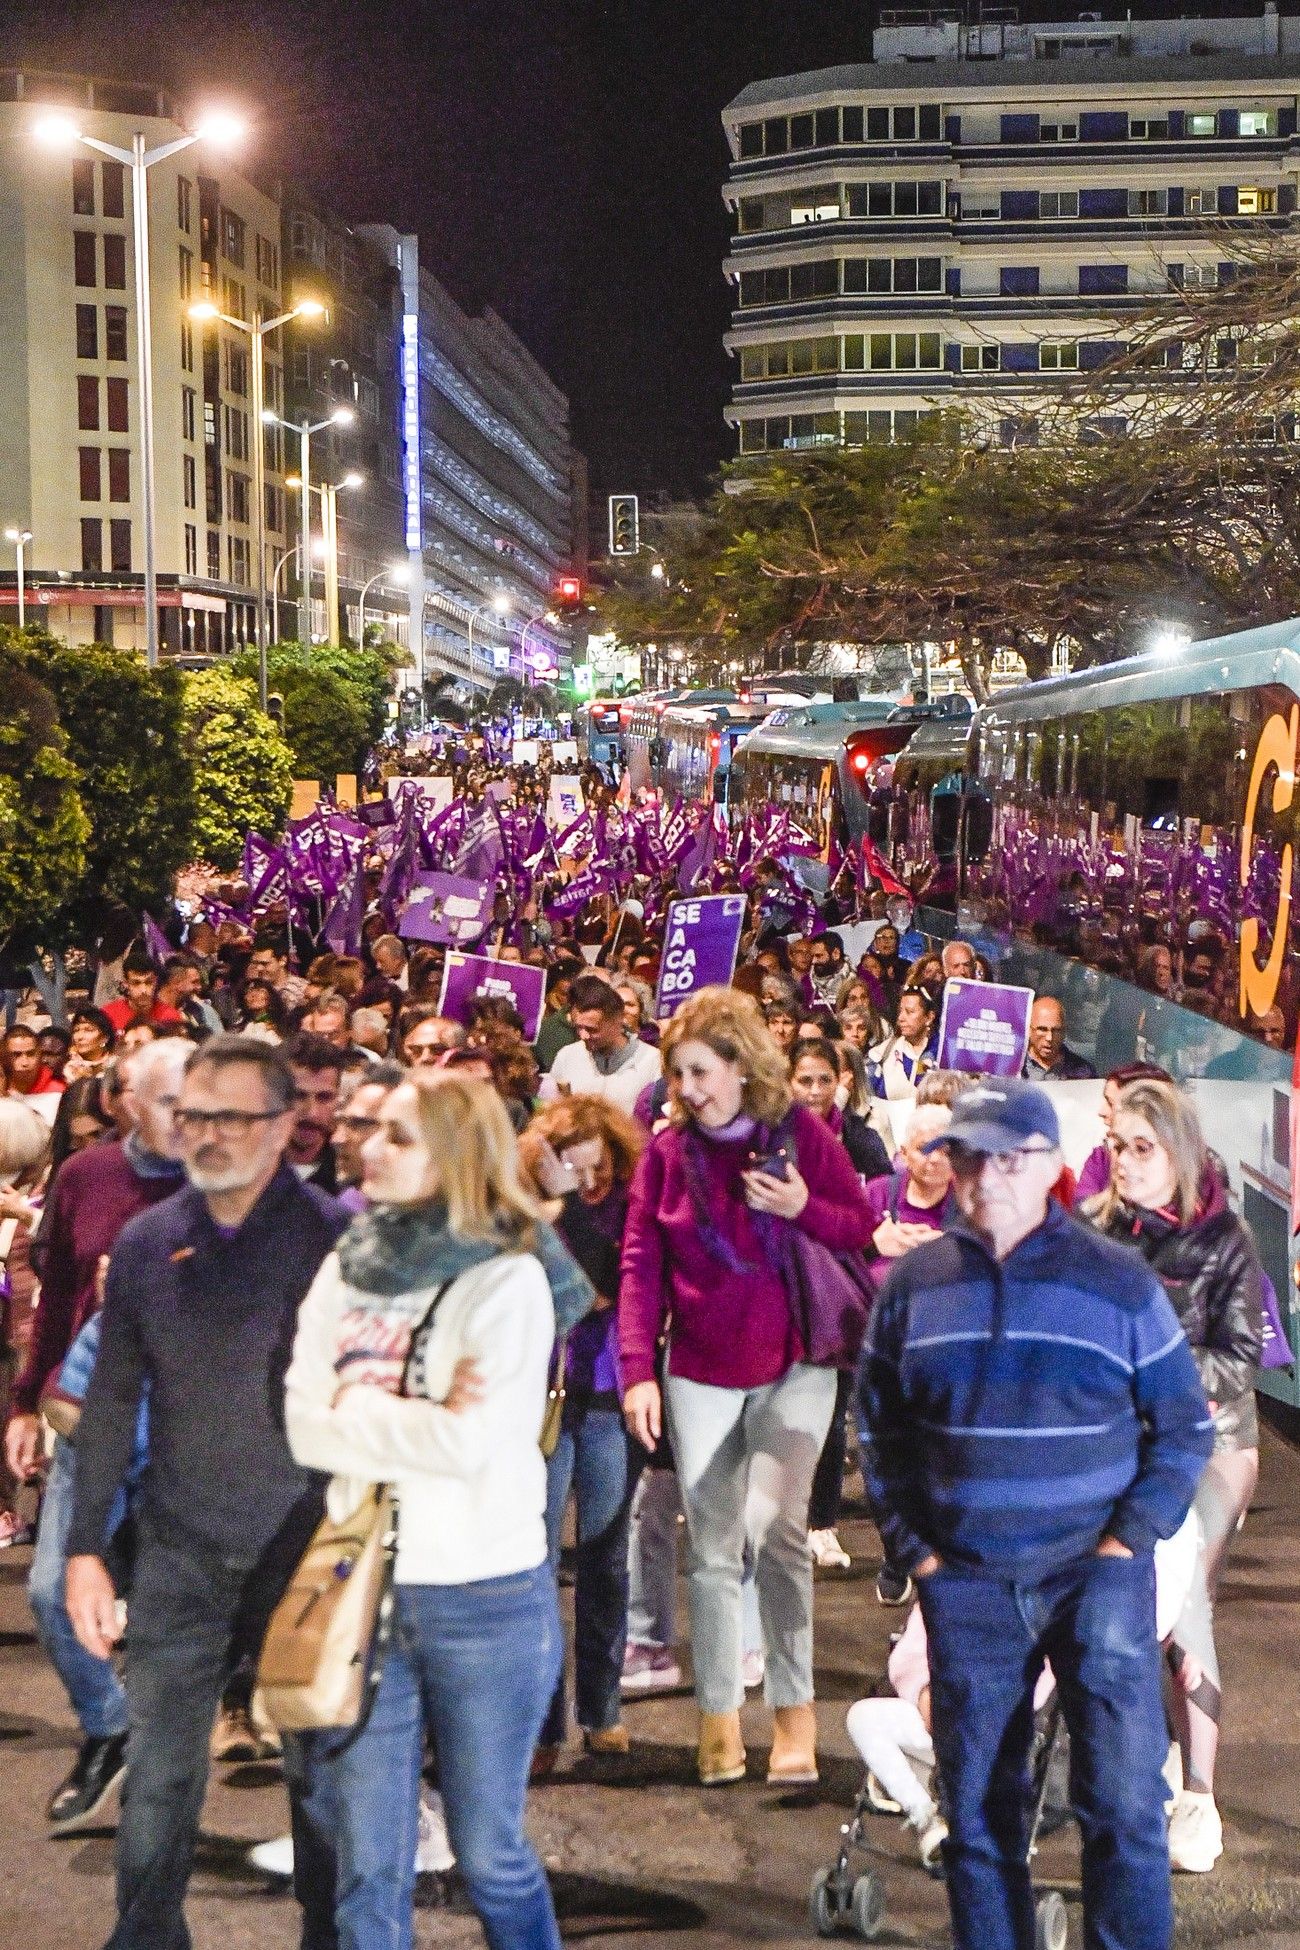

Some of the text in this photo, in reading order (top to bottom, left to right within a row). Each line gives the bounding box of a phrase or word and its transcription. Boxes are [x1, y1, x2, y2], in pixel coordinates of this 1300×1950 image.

[405, 347, 418, 528] PARKING TRIANA
[673, 903, 701, 925] SE
[670, 928, 686, 947] A
[666, 948, 696, 970] CA
